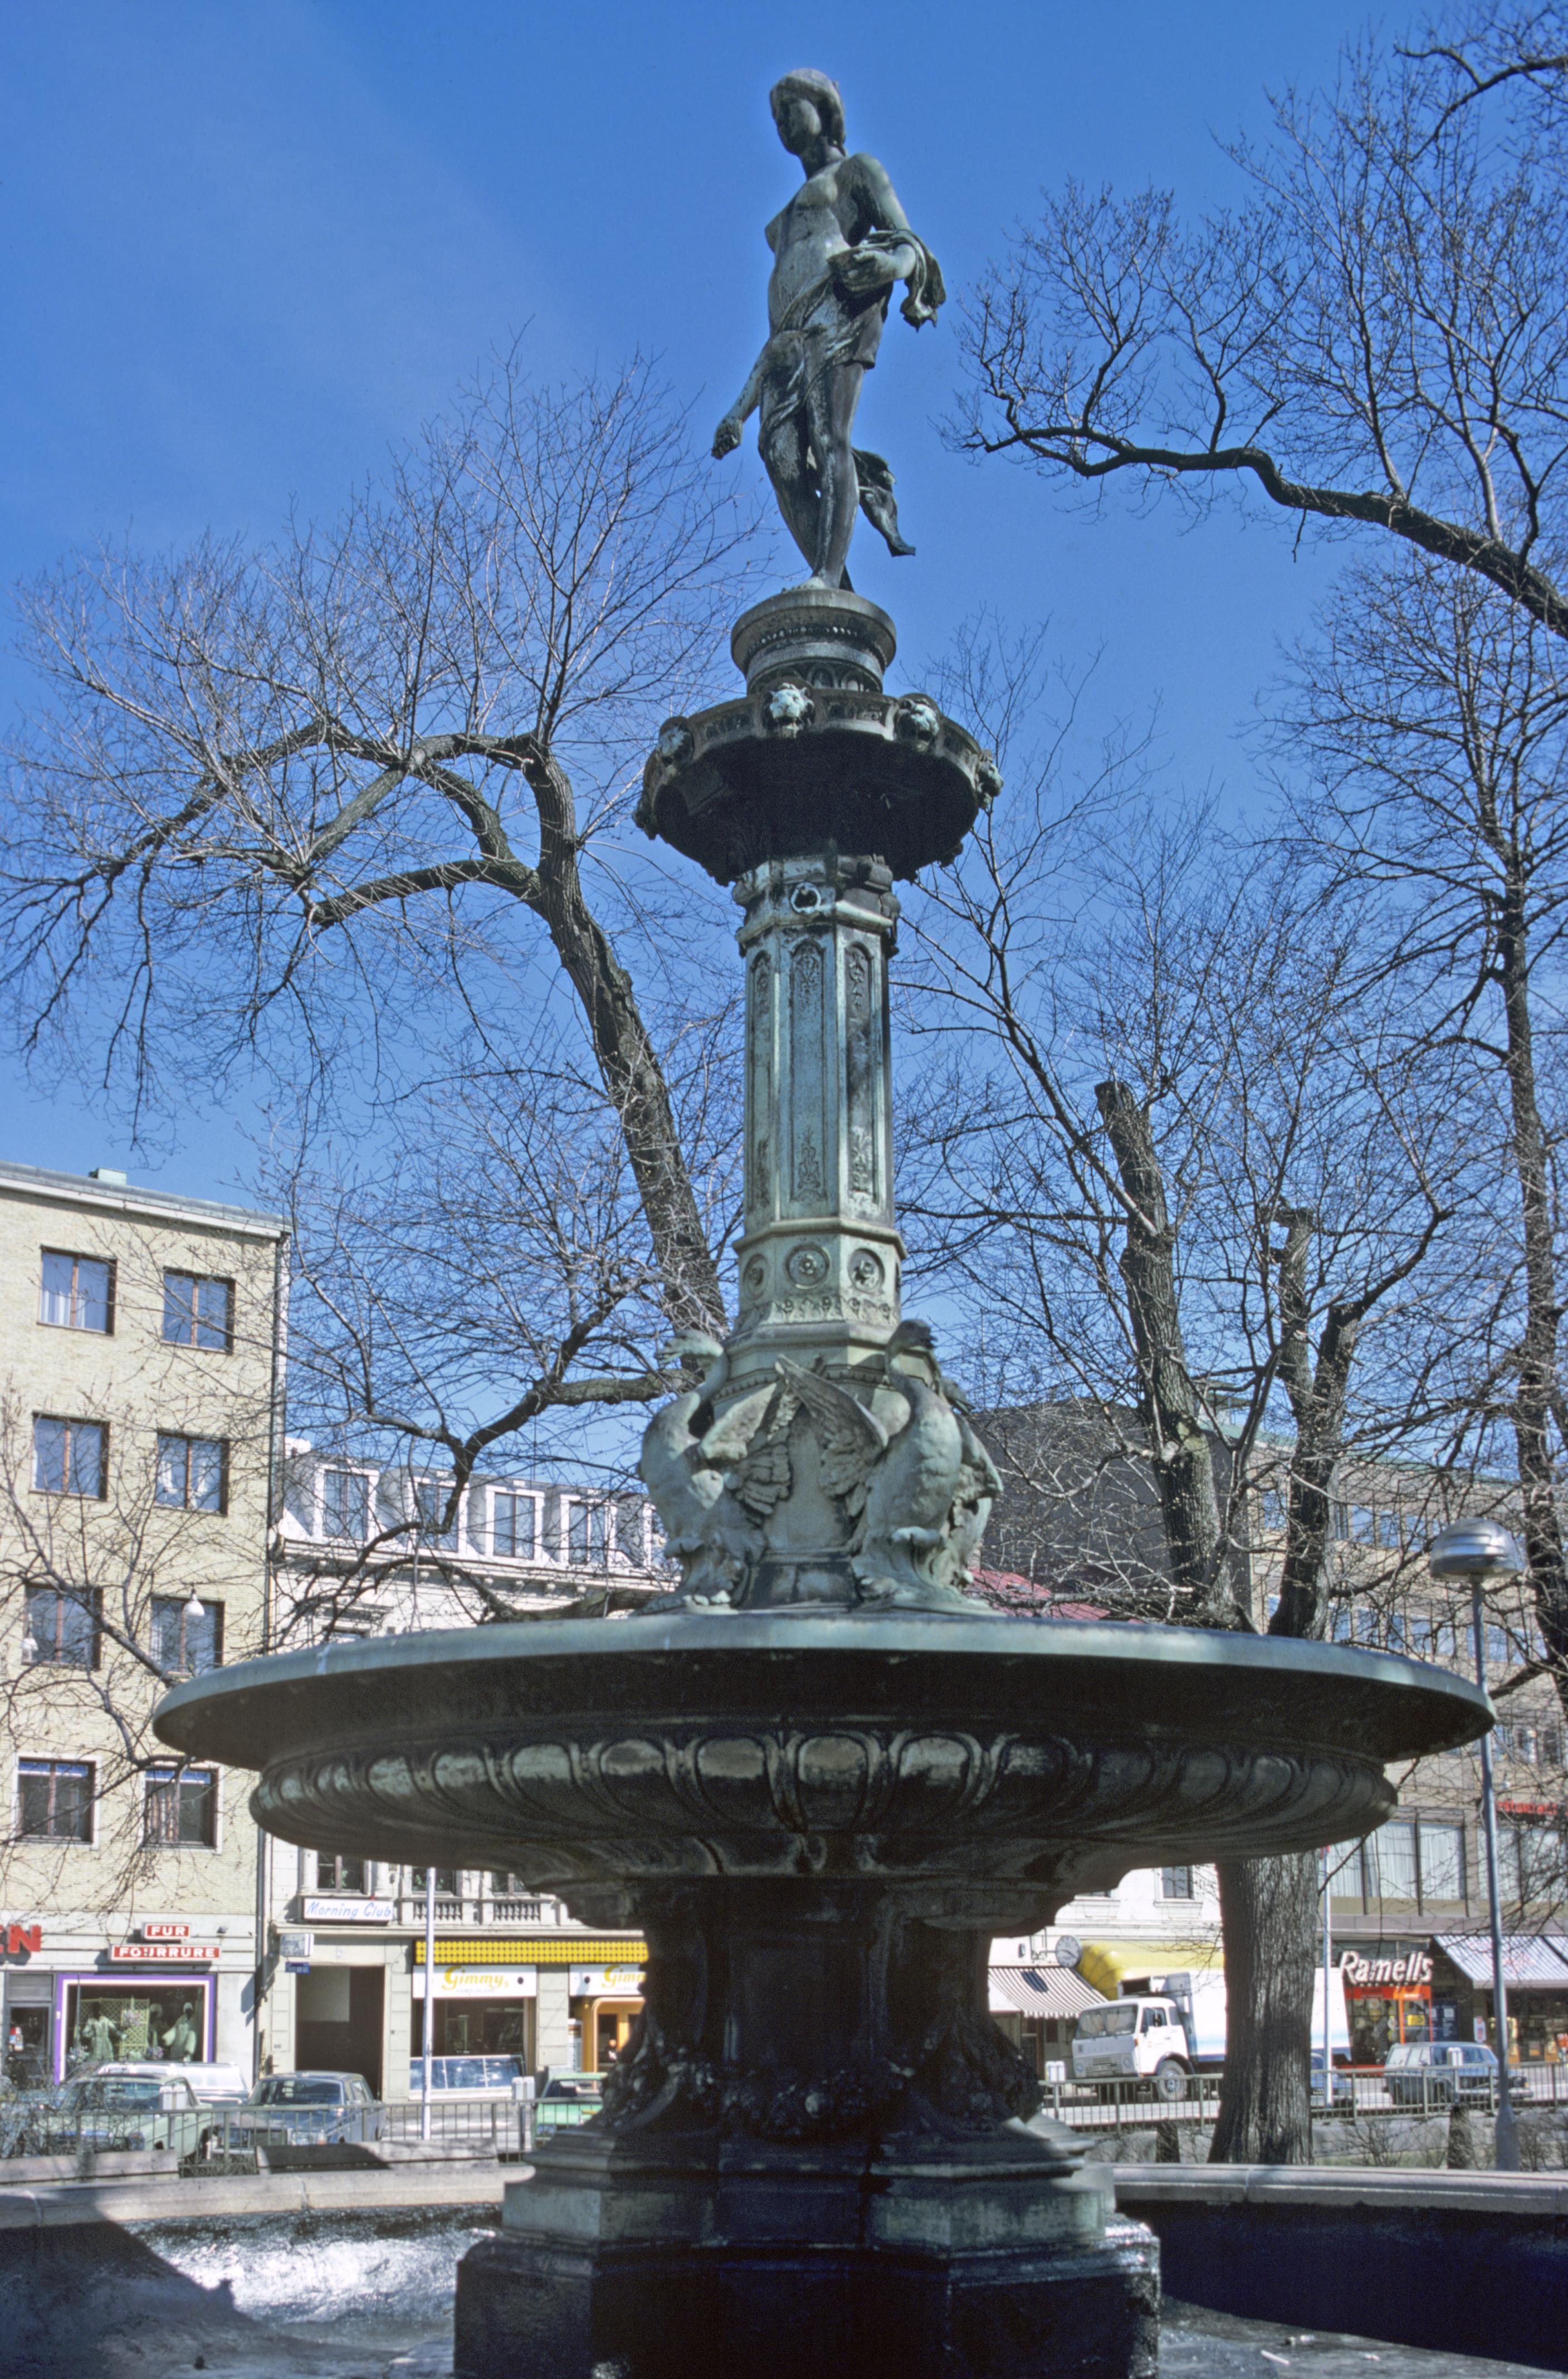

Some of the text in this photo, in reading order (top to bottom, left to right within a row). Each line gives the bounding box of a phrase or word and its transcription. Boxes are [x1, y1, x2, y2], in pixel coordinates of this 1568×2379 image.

[306, 1901, 392, 1920] Morning Club
[0, 1925, 41, 1953] N
[151, 1926, 185, 1936] FUR
[119, 1947, 215, 1957] FOURRURE
[1340, 1951, 1434, 1985] Ramells
